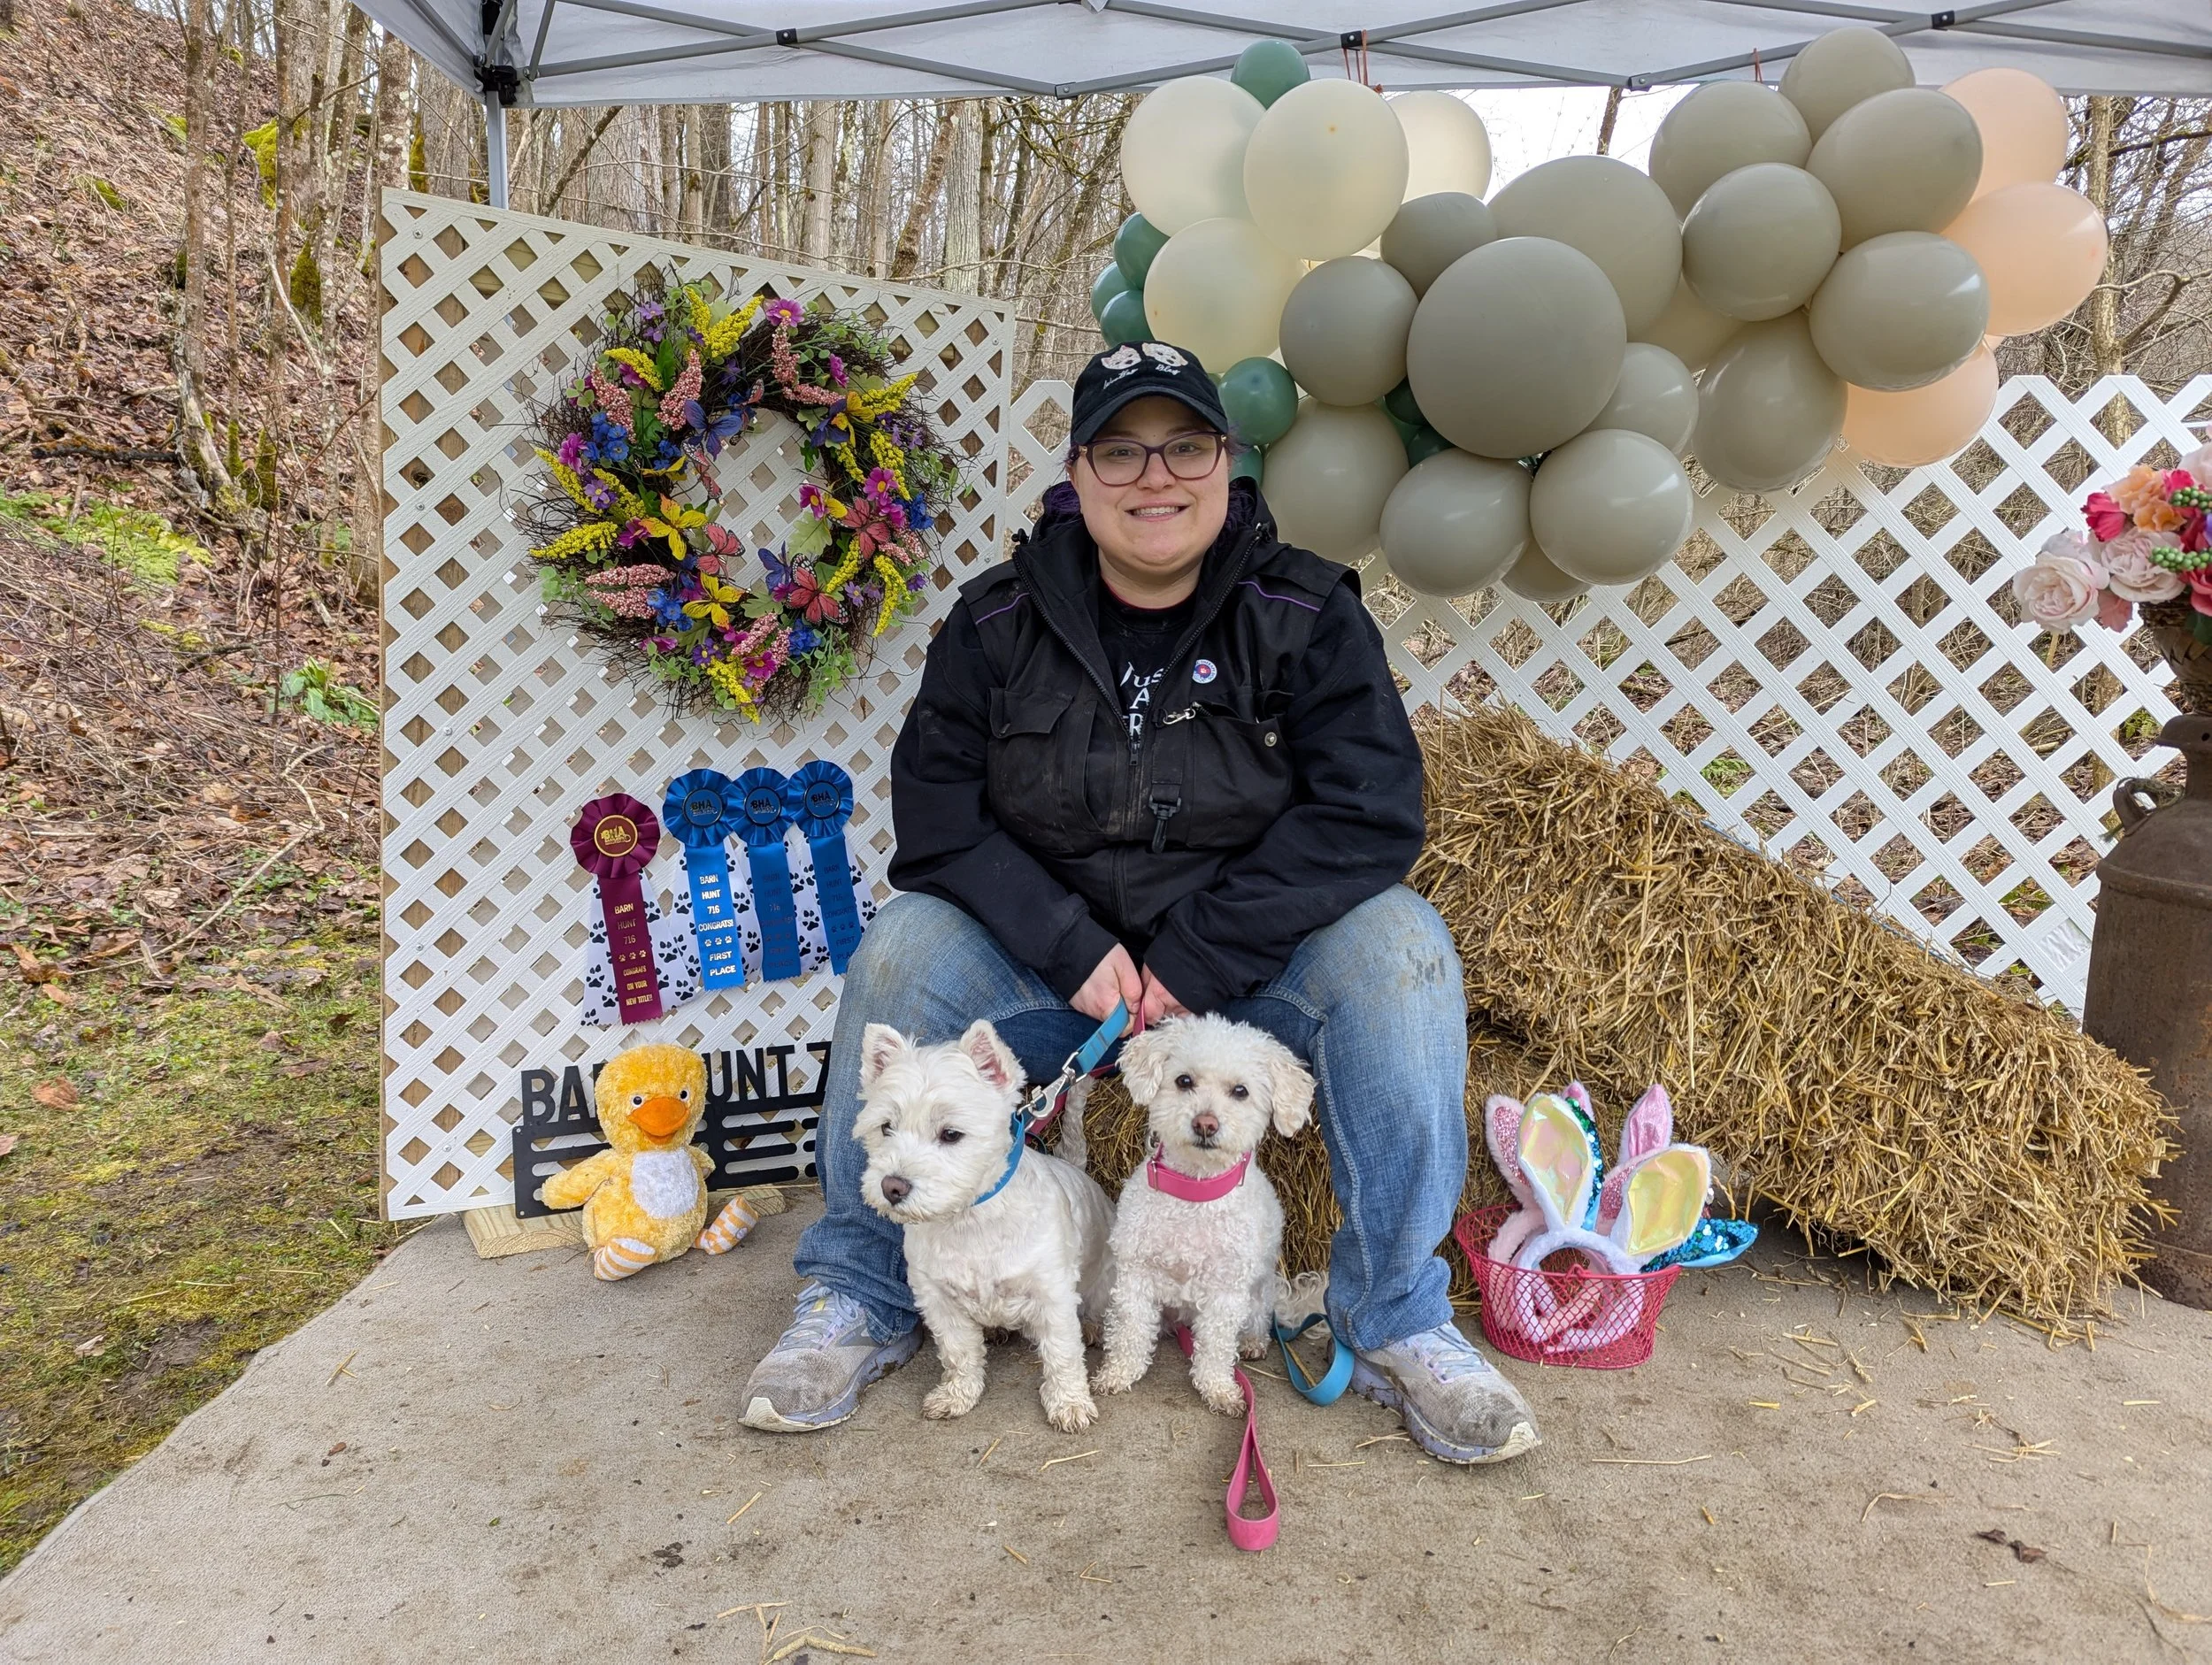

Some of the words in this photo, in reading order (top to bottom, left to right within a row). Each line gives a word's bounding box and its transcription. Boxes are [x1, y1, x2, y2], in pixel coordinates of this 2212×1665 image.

[1129, 687, 1150, 710] A
[750, 798, 772, 809] BHA
[810, 792, 831, 803] BHA
[691, 801, 713, 812] BHA
[601, 825, 626, 840] BHA
[699, 873, 719, 885] BARN
[701, 889, 721, 901] HUNT
[614, 902, 634, 915] BARN
[707, 905, 721, 915] 716
[617, 918, 637, 931] HUNT
[698, 918, 734, 932] CONGRATS!
[623, 934, 637, 945] 716
[835, 936, 856, 948] FIRST
[709, 951, 733, 962] FIRST
[623, 965, 647, 977] CONGRATS
[709, 965, 736, 977] PLACE
[626, 982, 634, 991] ON
[634, 979, 648, 990] YOUR
[626, 997, 637, 1006] NEW
[520, 1064, 605, 1127] BA
[702, 1044, 795, 1104] UNT
